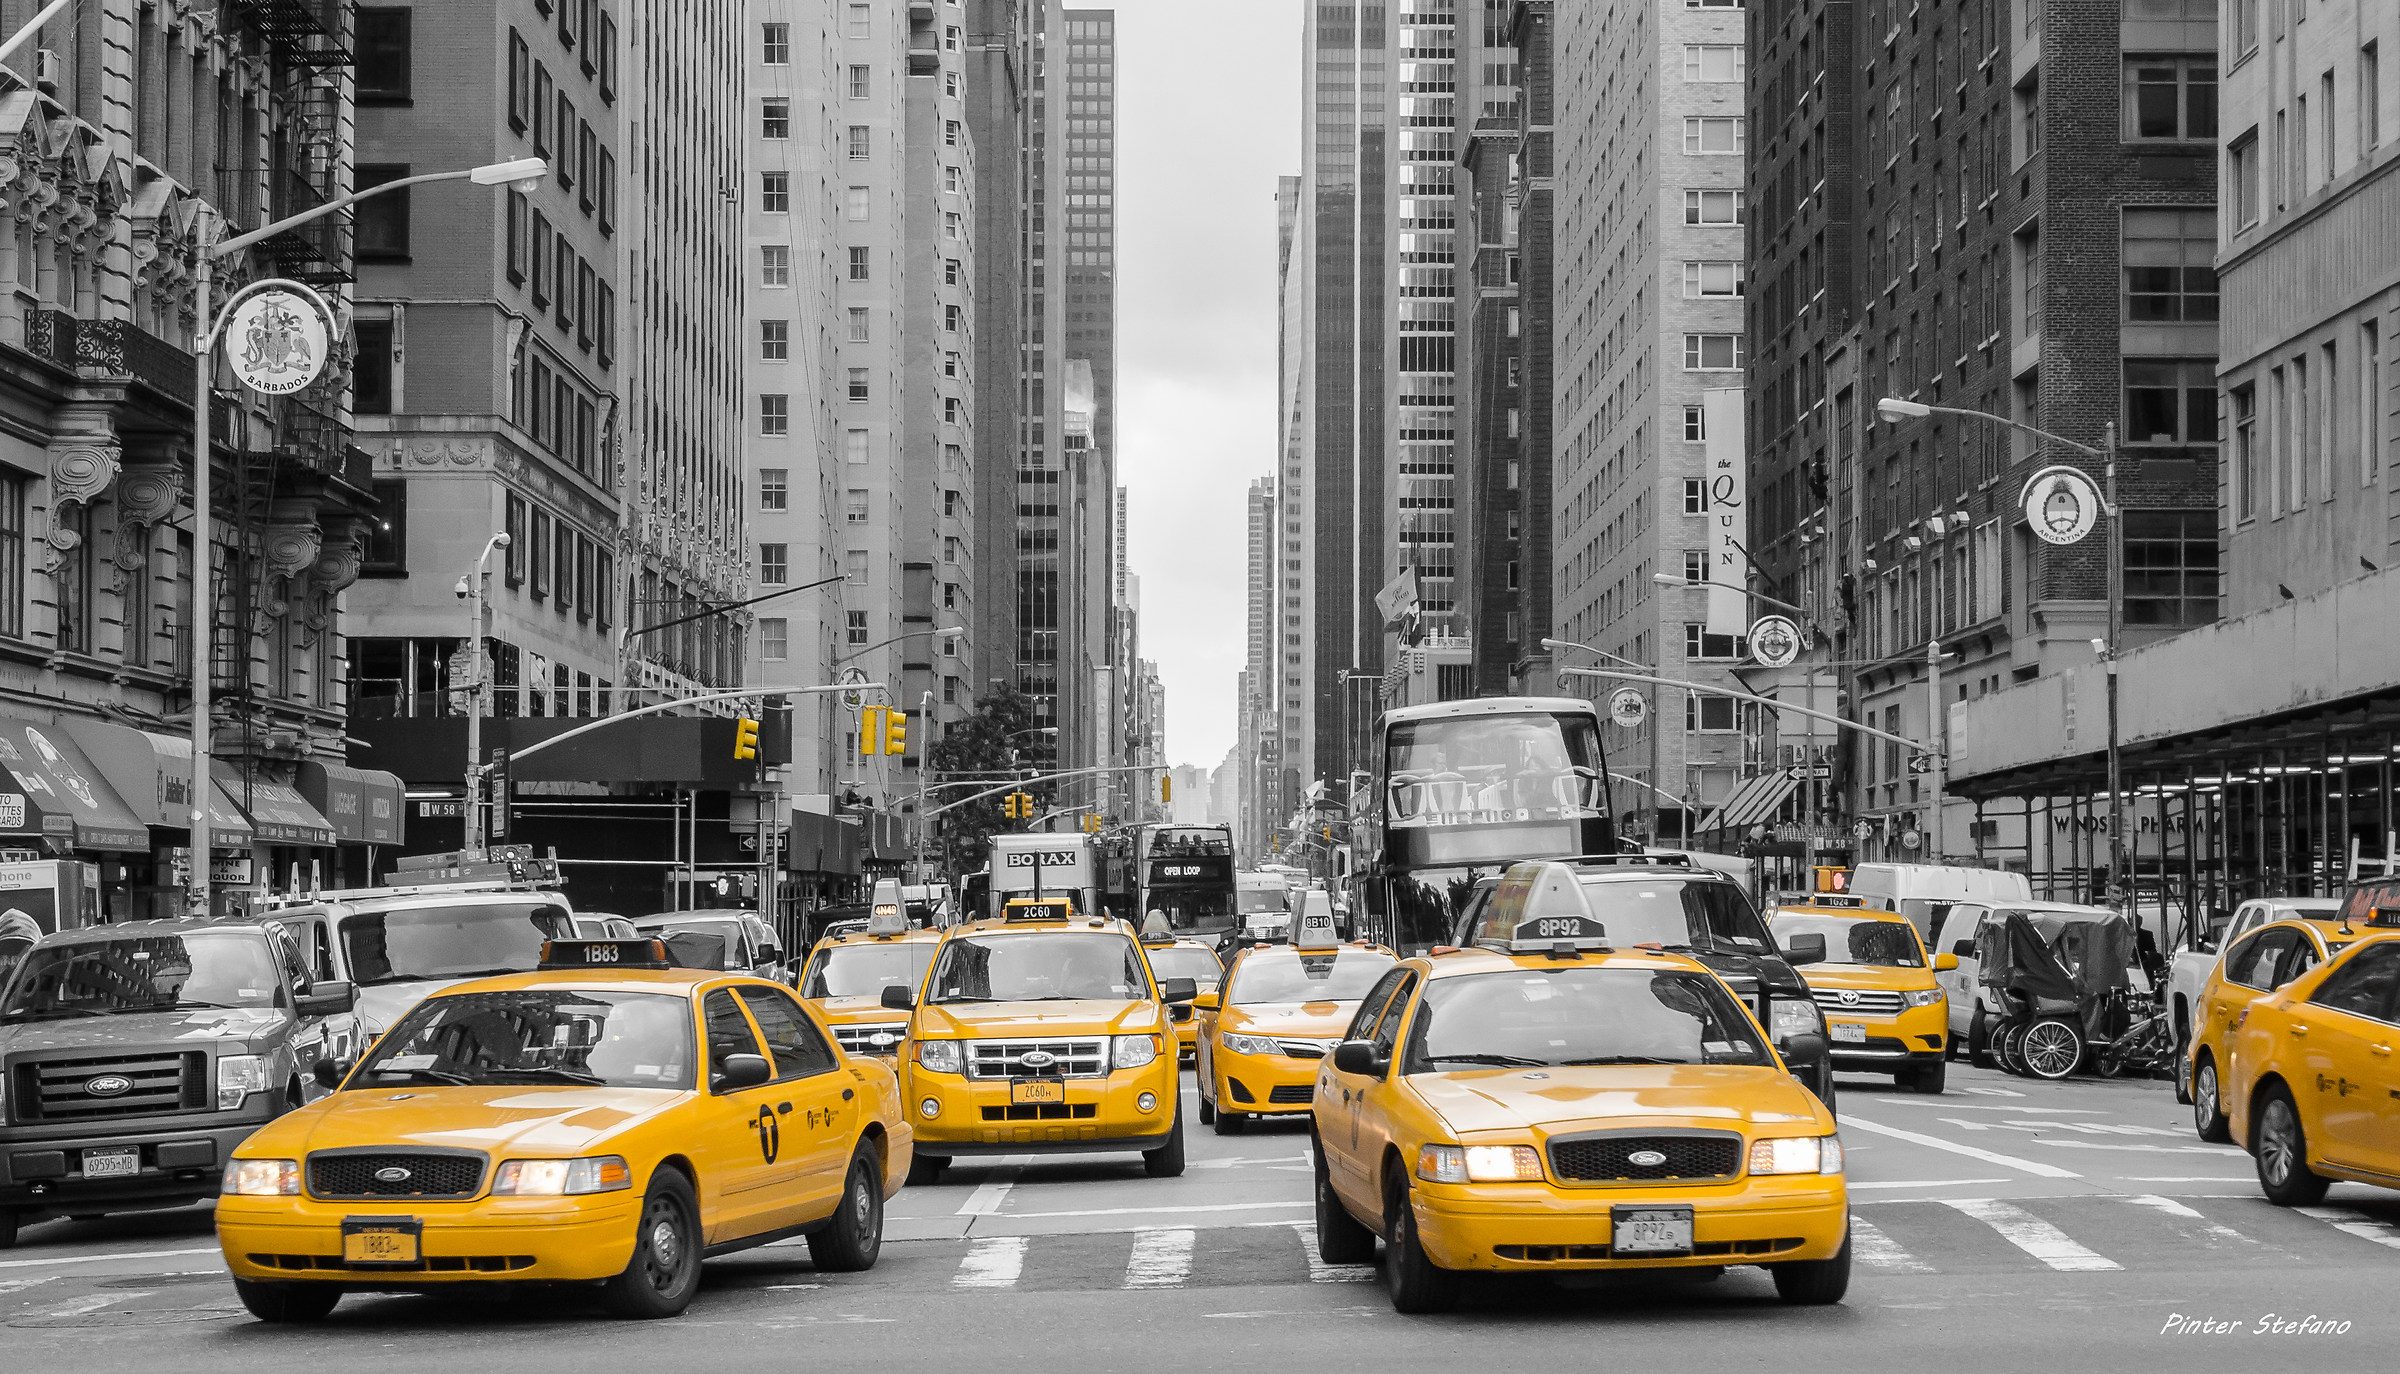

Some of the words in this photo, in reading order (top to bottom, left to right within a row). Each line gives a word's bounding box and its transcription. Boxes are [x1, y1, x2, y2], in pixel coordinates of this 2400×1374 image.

[247, 374, 308, 391] BARBADOS
[1718, 460, 1731, 468] the
[2038, 528, 2085, 542] ARGENTINA
[0, 806, 22, 816] TTES
[432, 805, 440, 815] W
[443, 804, 455, 815] 58
[0, 816, 21, 826] ARDS
[1825, 839, 1833, 848] W
[1836, 839, 1846, 849] 58
[1008, 853, 1075, 866] BORAX
[1164, 866, 1181, 875] OPEN
[1183, 866, 1200, 875] LOOP
[0, 871, 32, 881] hone
[1829, 898, 1848, 906] 1G24
[875, 905, 897, 915] 4N49
[1023, 906, 1050, 917] 2C60
[1306, 917, 1330, 927] 8B10
[1539, 919, 1580, 936] 8P92
[583, 944, 619, 962] 1B83
[96, 1079, 120, 1090] Ford
